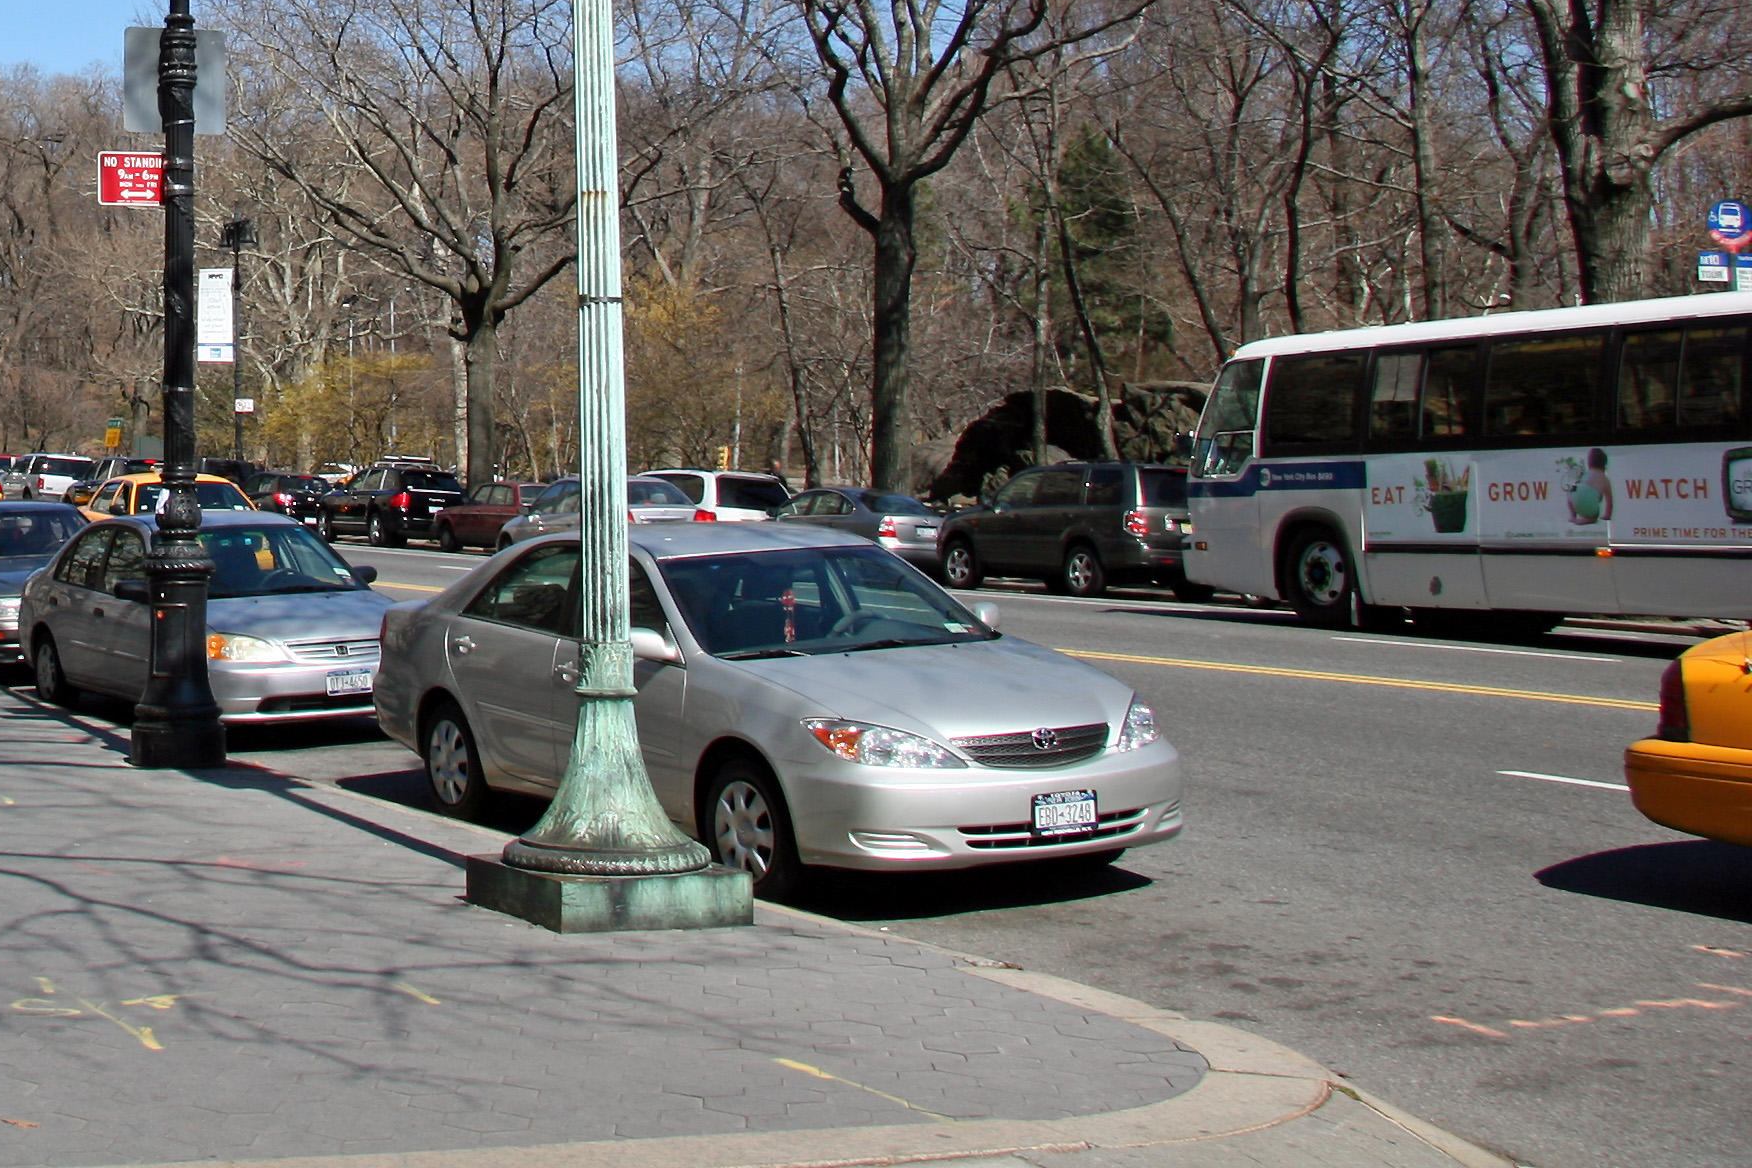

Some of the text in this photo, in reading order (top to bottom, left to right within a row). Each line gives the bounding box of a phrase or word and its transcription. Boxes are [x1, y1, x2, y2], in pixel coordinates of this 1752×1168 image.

[103, 156, 117, 168] NO
[1371, 486, 1406, 505] EAT
[1488, 480, 1548, 502] GROW
[1625, 477, 1709, 500] WATCH
[1633, 527, 1668, 538] PRIME
[1672, 527, 1700, 538] TIME
[1704, 527, 1727, 539] FOR
